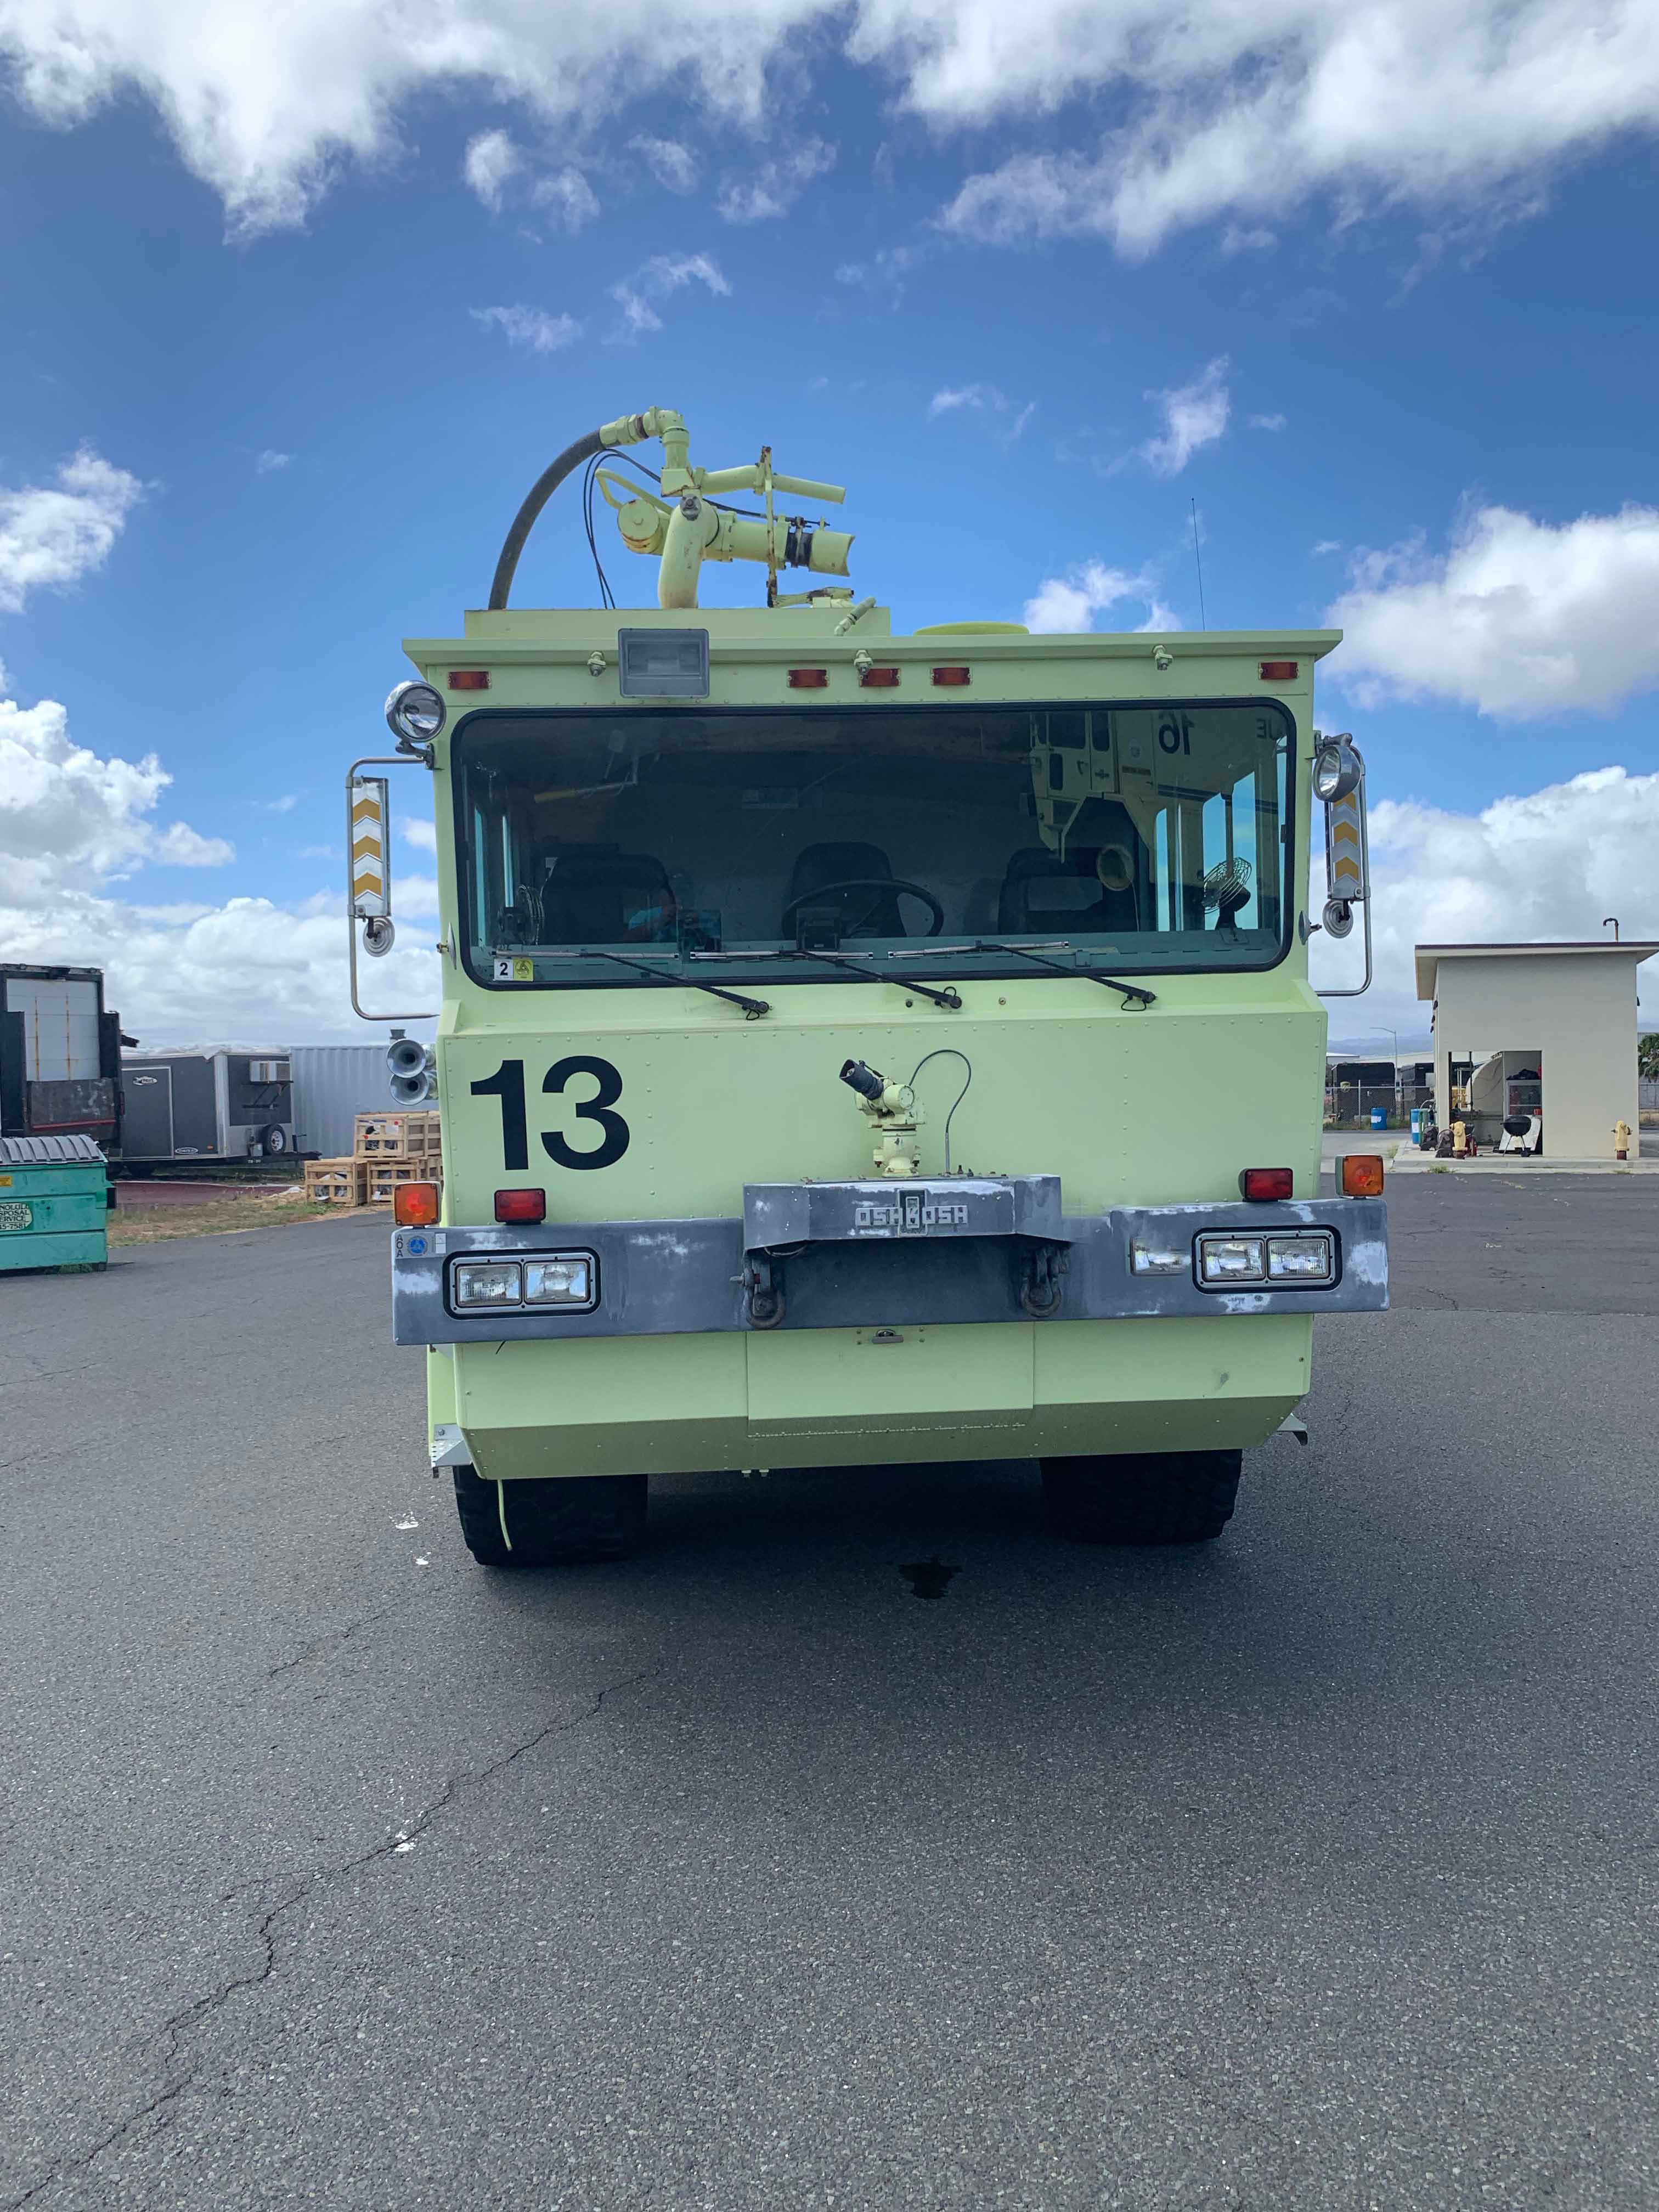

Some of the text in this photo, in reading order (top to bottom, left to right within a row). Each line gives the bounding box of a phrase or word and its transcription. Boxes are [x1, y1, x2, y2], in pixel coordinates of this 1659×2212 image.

[500, 962, 508, 975] 2
[470, 1056, 630, 1170] 13
[855, 1196, 967, 1229] OSHKOSH
